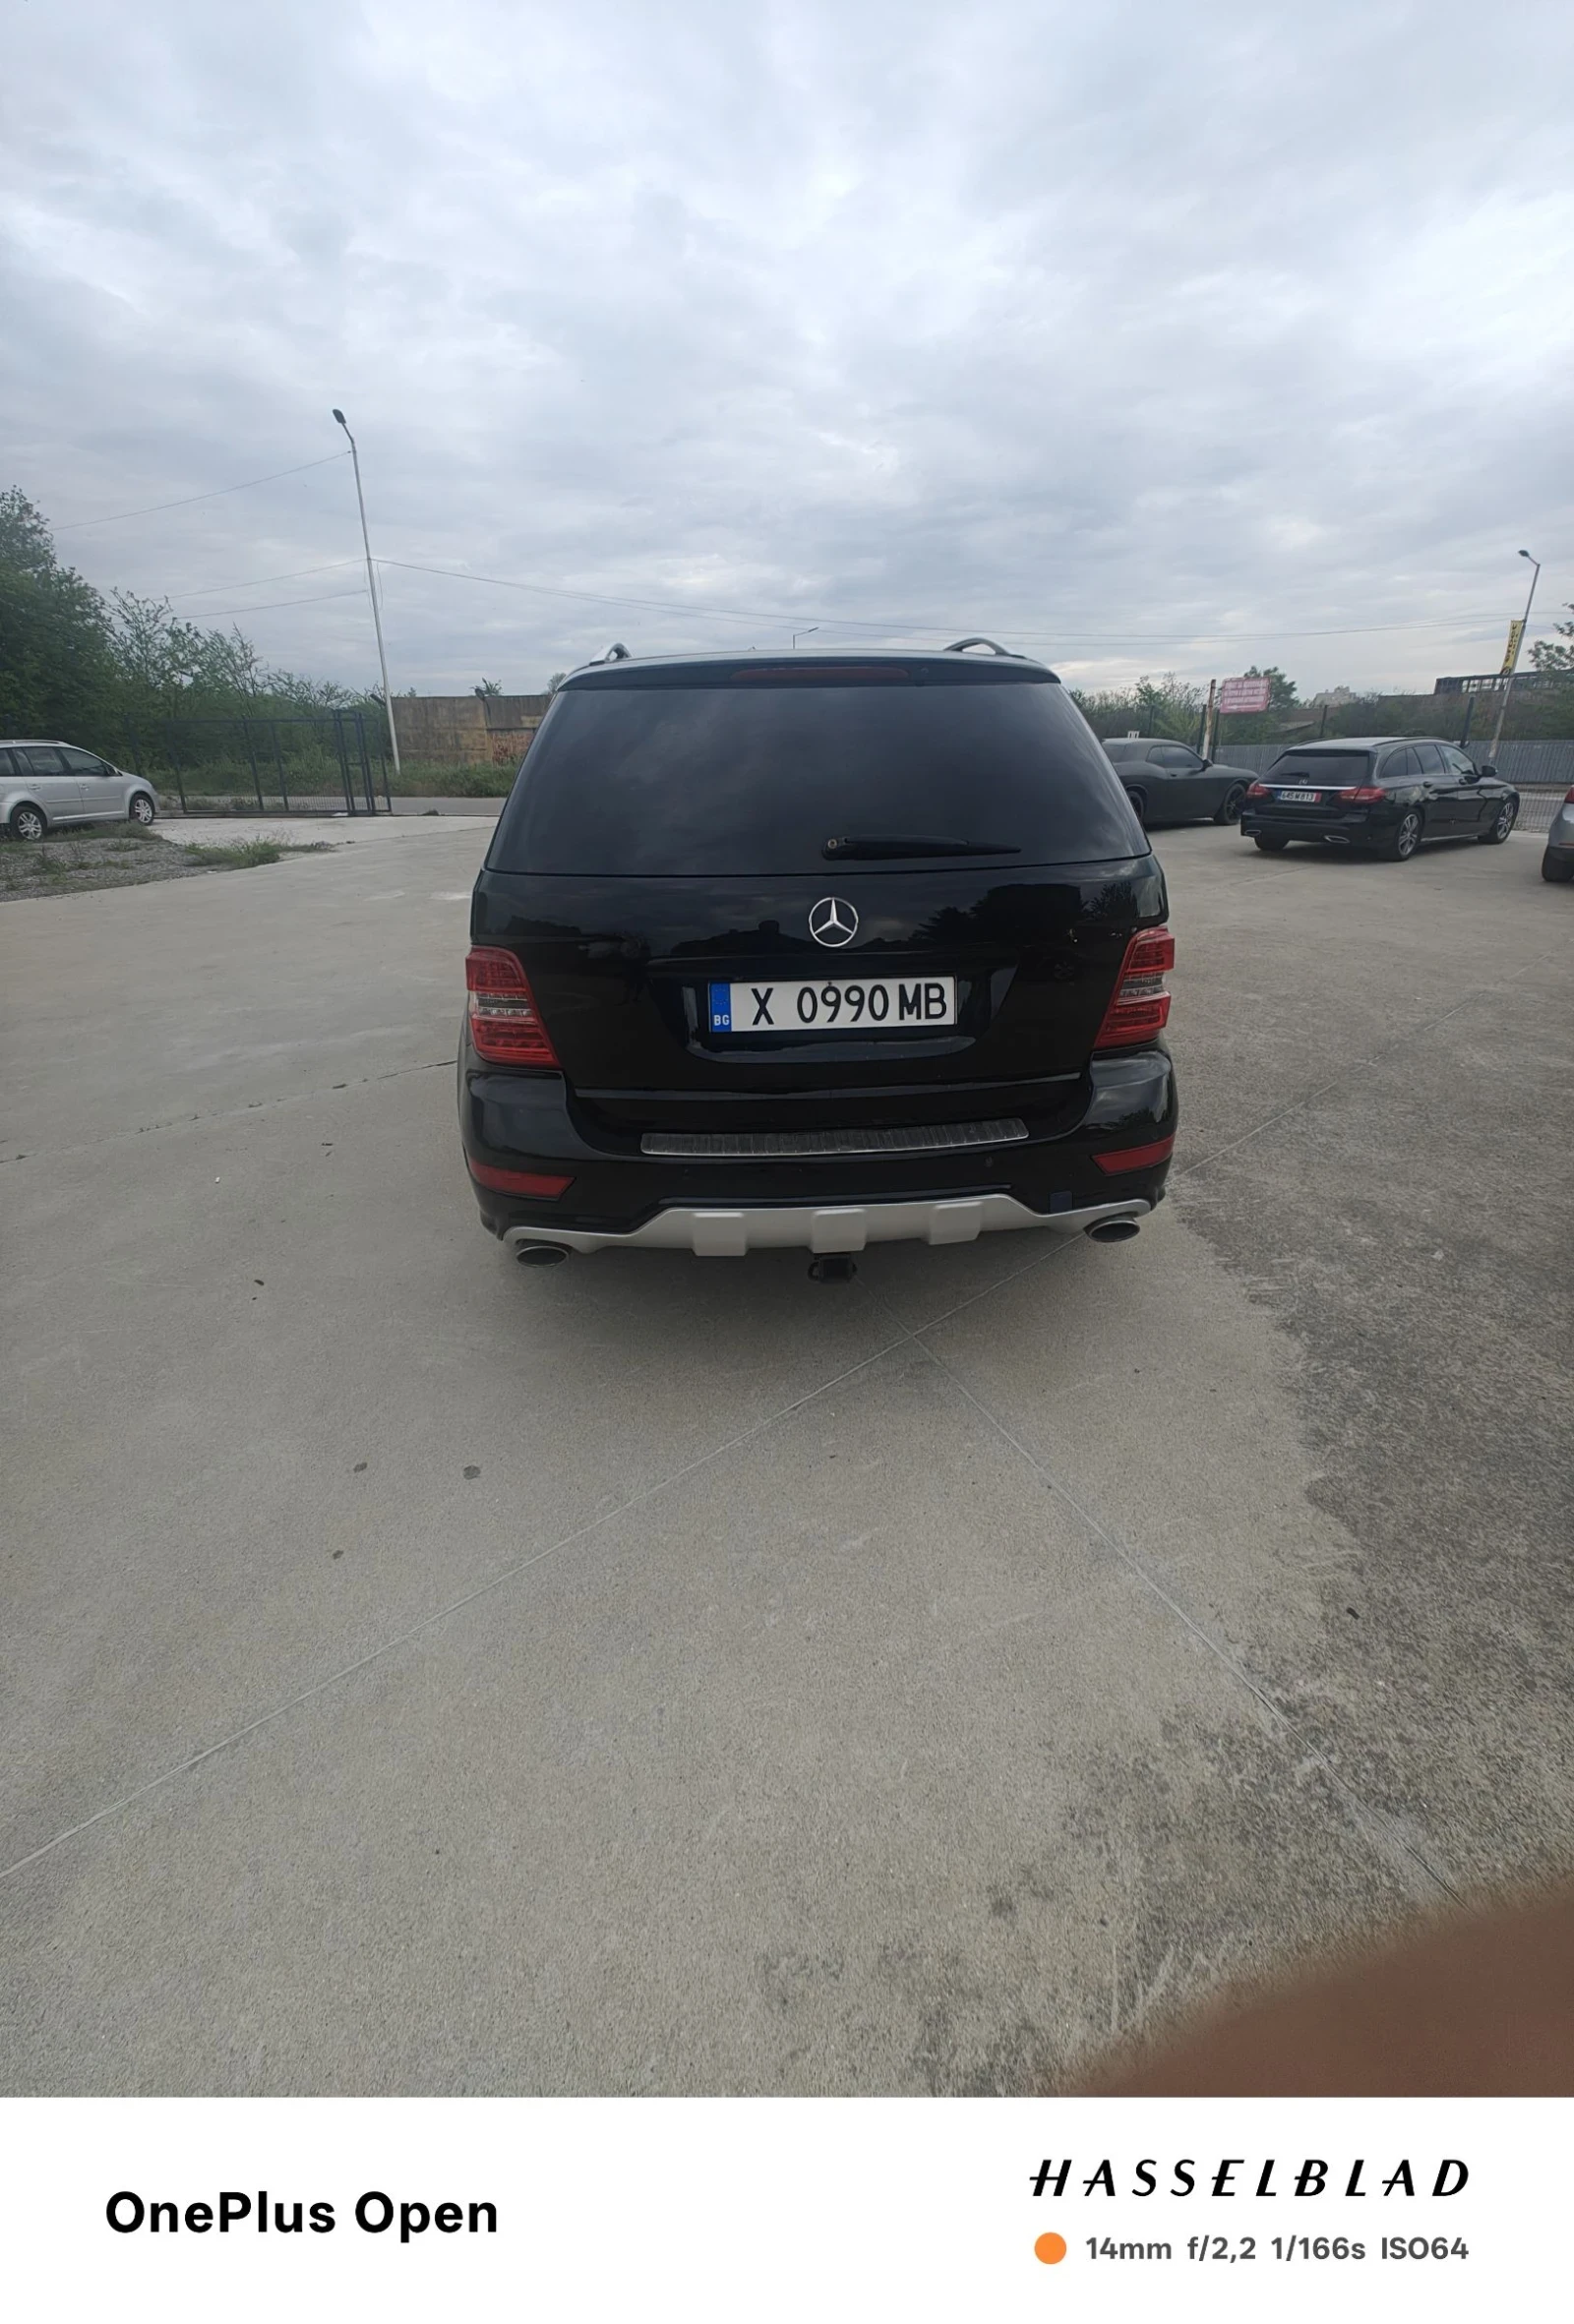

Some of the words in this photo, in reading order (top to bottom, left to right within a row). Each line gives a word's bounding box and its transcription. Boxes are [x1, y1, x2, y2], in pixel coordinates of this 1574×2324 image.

[751, 987, 774, 1025] X
[797, 984, 889, 1023] 0990
[898, 983, 946, 1020] MB
[713, 1015, 730, 1026] BG
